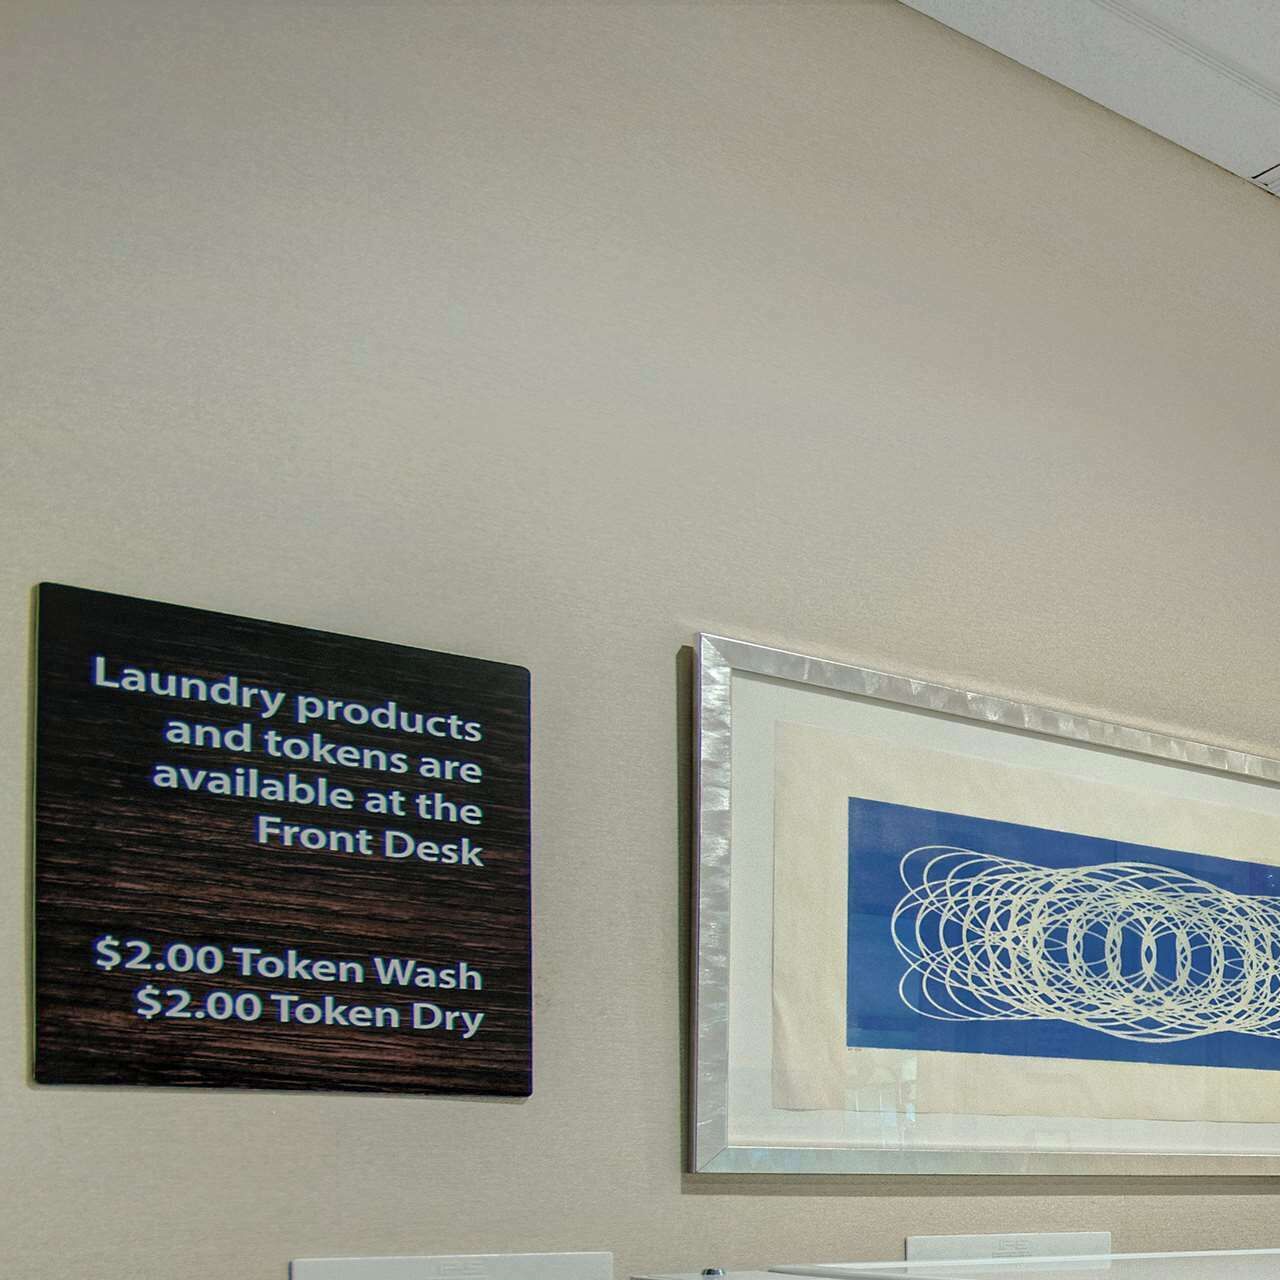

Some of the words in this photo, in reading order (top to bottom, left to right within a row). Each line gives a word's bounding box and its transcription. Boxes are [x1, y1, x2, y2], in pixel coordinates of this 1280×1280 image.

[94, 656, 286, 719] Laundry
[297, 695, 482, 742] products
[166, 720, 251, 753] and
[263, 730, 409, 773] tokens
[419, 757, 483, 784] are
[153, 764, 354, 809] available
[365, 788, 406, 816] at
[415, 792, 483, 825] the
[258, 815, 373, 855] Front
[384, 831, 485, 867] Desk
[95, 935, 223, 975] $2.00
[232, 946, 364, 984] Token
[373, 957, 482, 991] Wash
[136, 984, 262, 1022] $2.00
[270, 994, 400, 1029] Token
[412, 1002, 485, 1039] Dry
